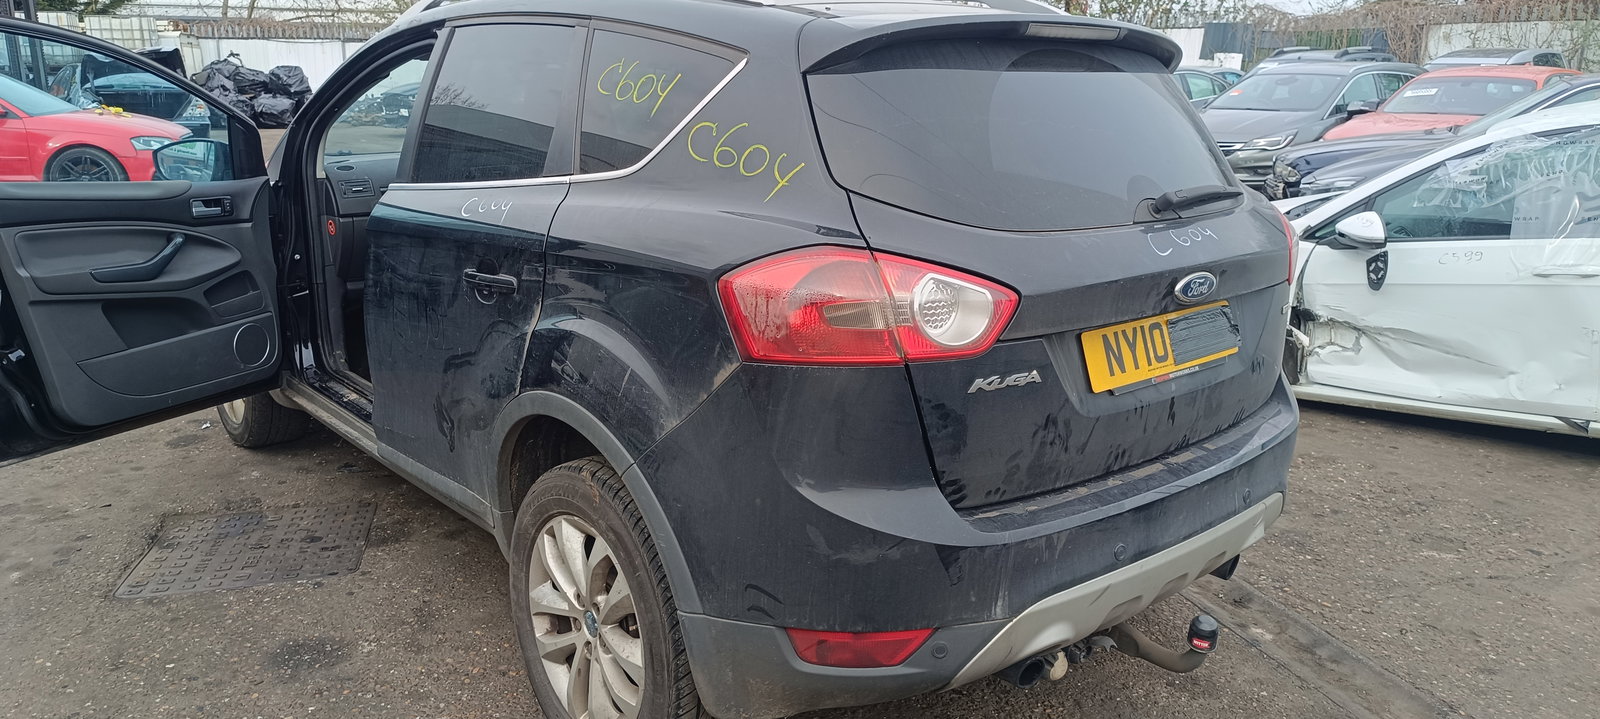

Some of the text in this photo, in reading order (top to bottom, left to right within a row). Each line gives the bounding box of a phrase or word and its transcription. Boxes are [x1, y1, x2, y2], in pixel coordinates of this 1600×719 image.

[598, 58, 682, 119] C604
[688, 121, 806, 203] C604
[1188, 279, 1209, 297] Ford
[1102, 322, 1169, 377] NY10
[967, 369, 1043, 394] KUGA
